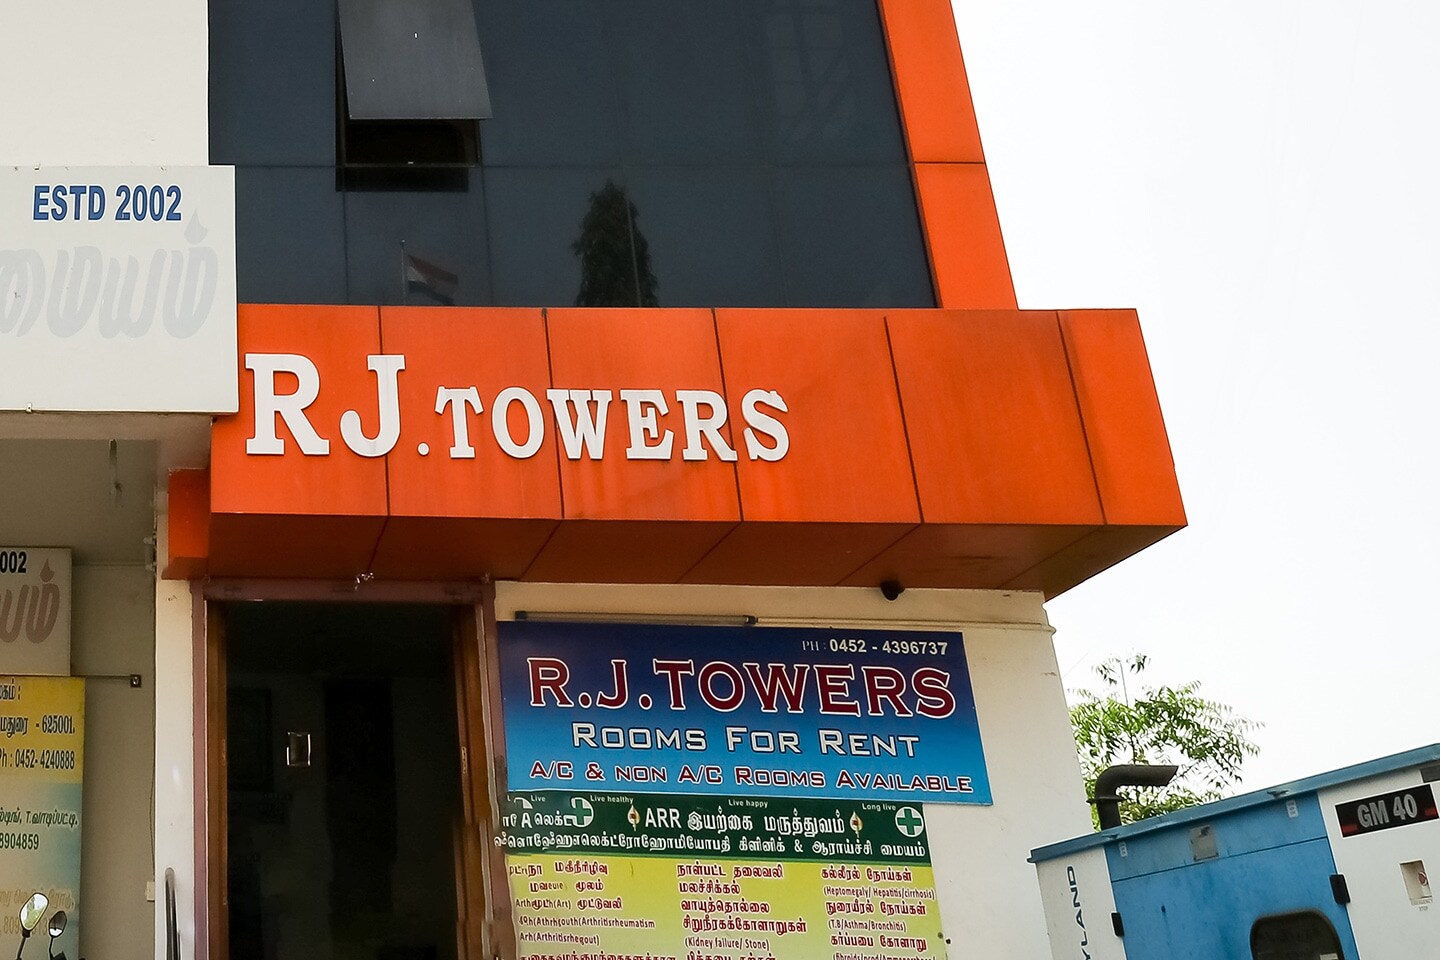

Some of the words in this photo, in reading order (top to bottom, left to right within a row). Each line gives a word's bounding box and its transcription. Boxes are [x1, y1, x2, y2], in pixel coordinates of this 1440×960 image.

[32, 184, 106, 222] ESTD
[114, 184, 183, 222] 2002
[802, 640, 820, 651] PH
[829, 639, 867, 653] 0452
[882, 641, 948, 656] 4396737
[530, 761, 573, 780] A/C
[586, 761, 605, 781] &
[678, 764, 722, 785] A/C
[590, 795, 605, 803] Live
[607, 795, 634, 805] healthy
[728, 799, 744, 807] Live
[746, 800, 768, 809] happy
[862, 803, 881, 812] Long
[883, 803, 897, 811] live
[1357, 800, 1390, 828] GM
[1393, 794, 1418, 820] 40
[644, 808, 682, 828] ARR
[687, 805, 753, 834] இயற்கை
[763, 808, 845, 838] மருத்துவம்
[739, 836, 786, 853] கிளினிக்
[794, 839, 804, 853] &
[812, 838, 873, 856] ஆராய்ச்சி
[880, 841, 926, 857] மையம்
[677, 861, 727, 877] நாள்பட்ட
[733, 864, 783, 879] தலைவலி
[821, 865, 861, 880] கல்லீரல்
[866, 867, 912, 882] நோய்கள்
[575, 879, 604, 893] மூலம்
[679, 878, 740, 894] மலச்சிக்கல்
[577, 897, 622, 910] மூட்டுவலி
[681, 897, 770, 914] வாயுத்தொல்லை
[826, 898, 874, 915] நுரையீரல்
[880, 900, 926, 916] நோய்கள்
[879, 935, 927, 952] கோளாறு
